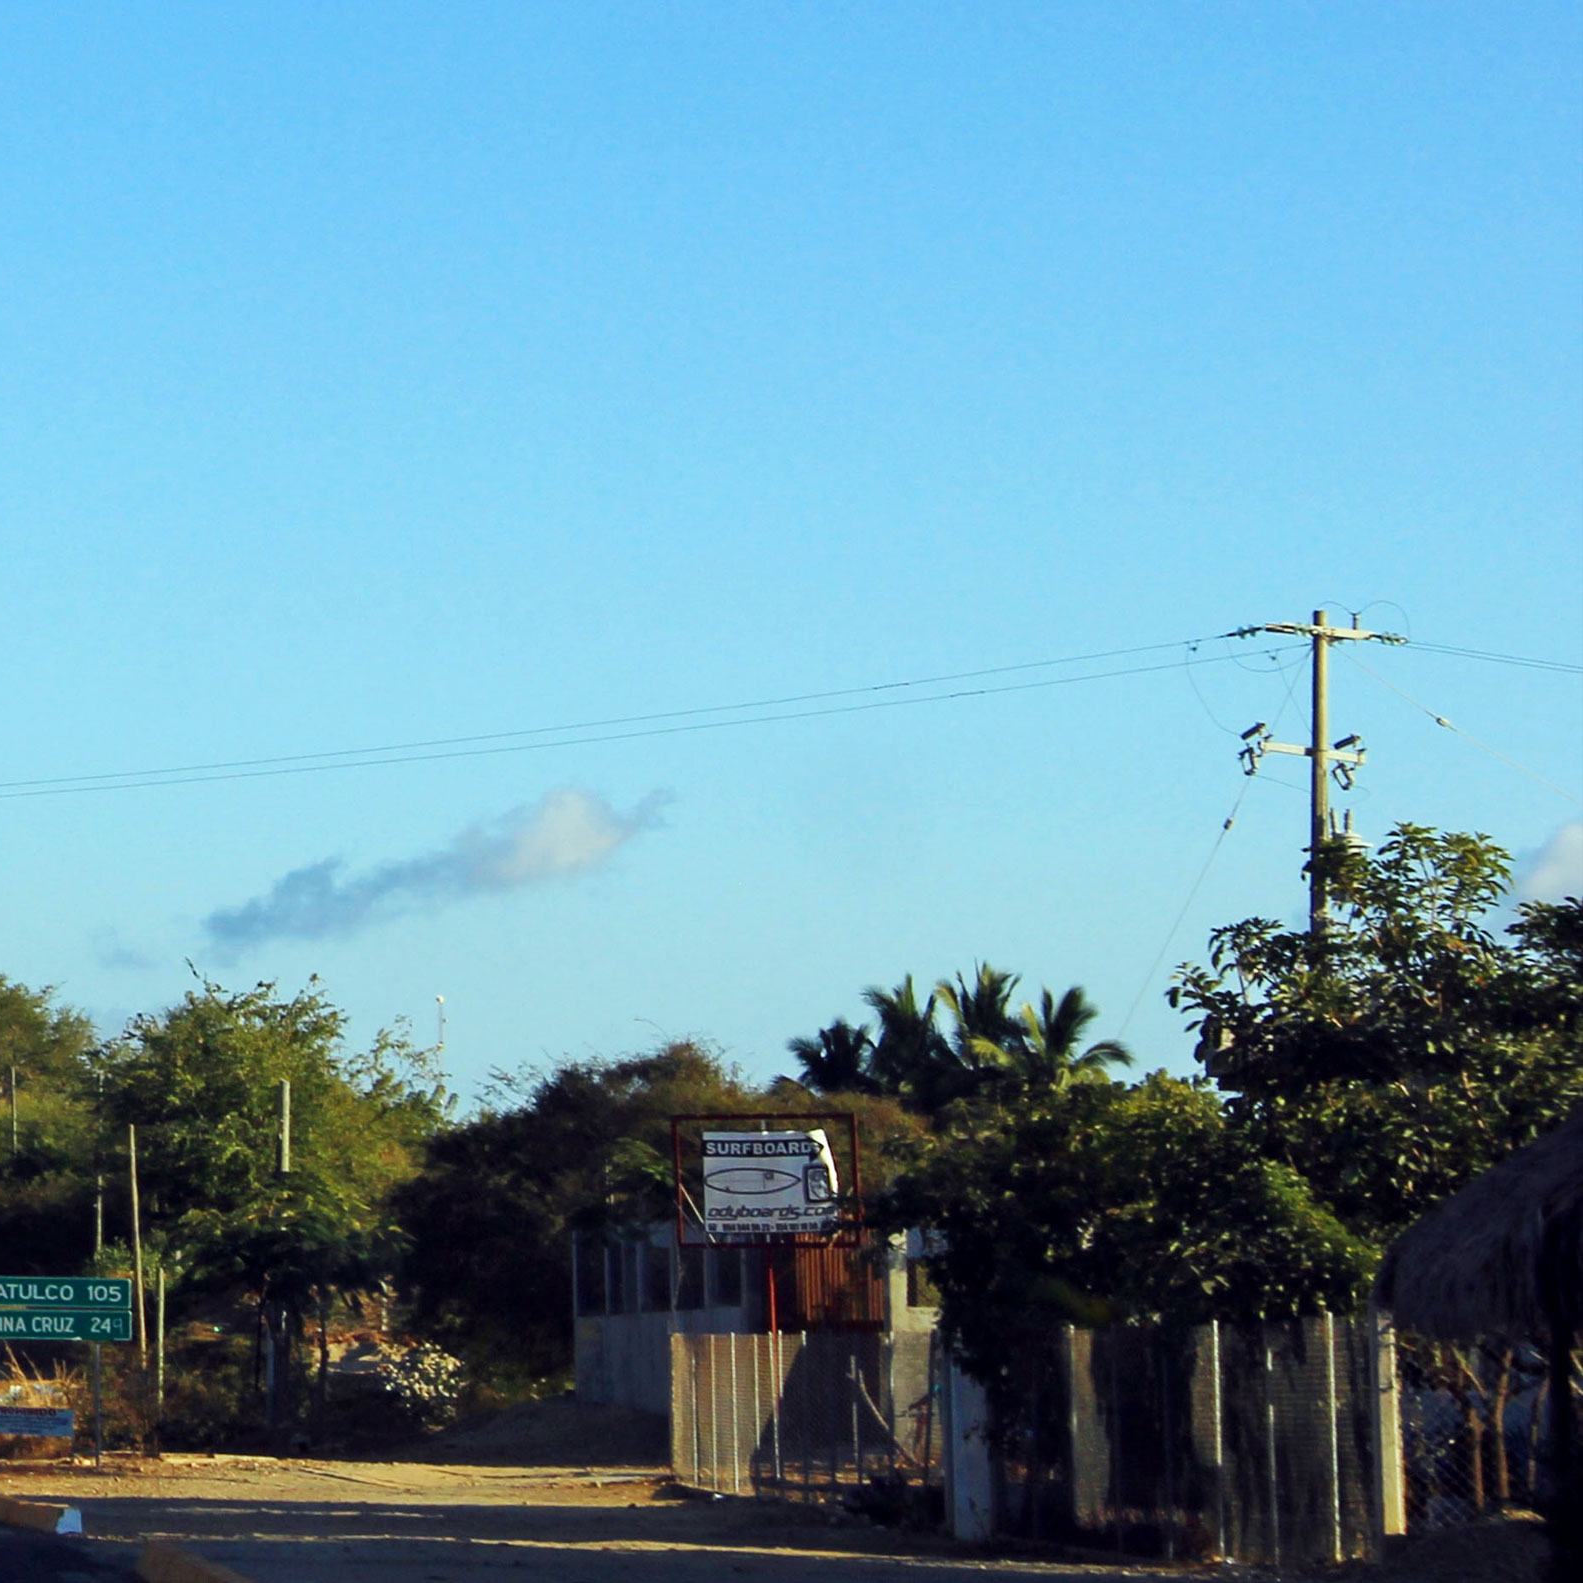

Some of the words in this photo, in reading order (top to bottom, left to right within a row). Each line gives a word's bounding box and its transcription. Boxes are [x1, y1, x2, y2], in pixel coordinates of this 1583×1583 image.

[87, 1285, 122, 1302] 105
[31, 1316, 75, 1333] CRUZ
[90, 1317, 123, 1334] 249
